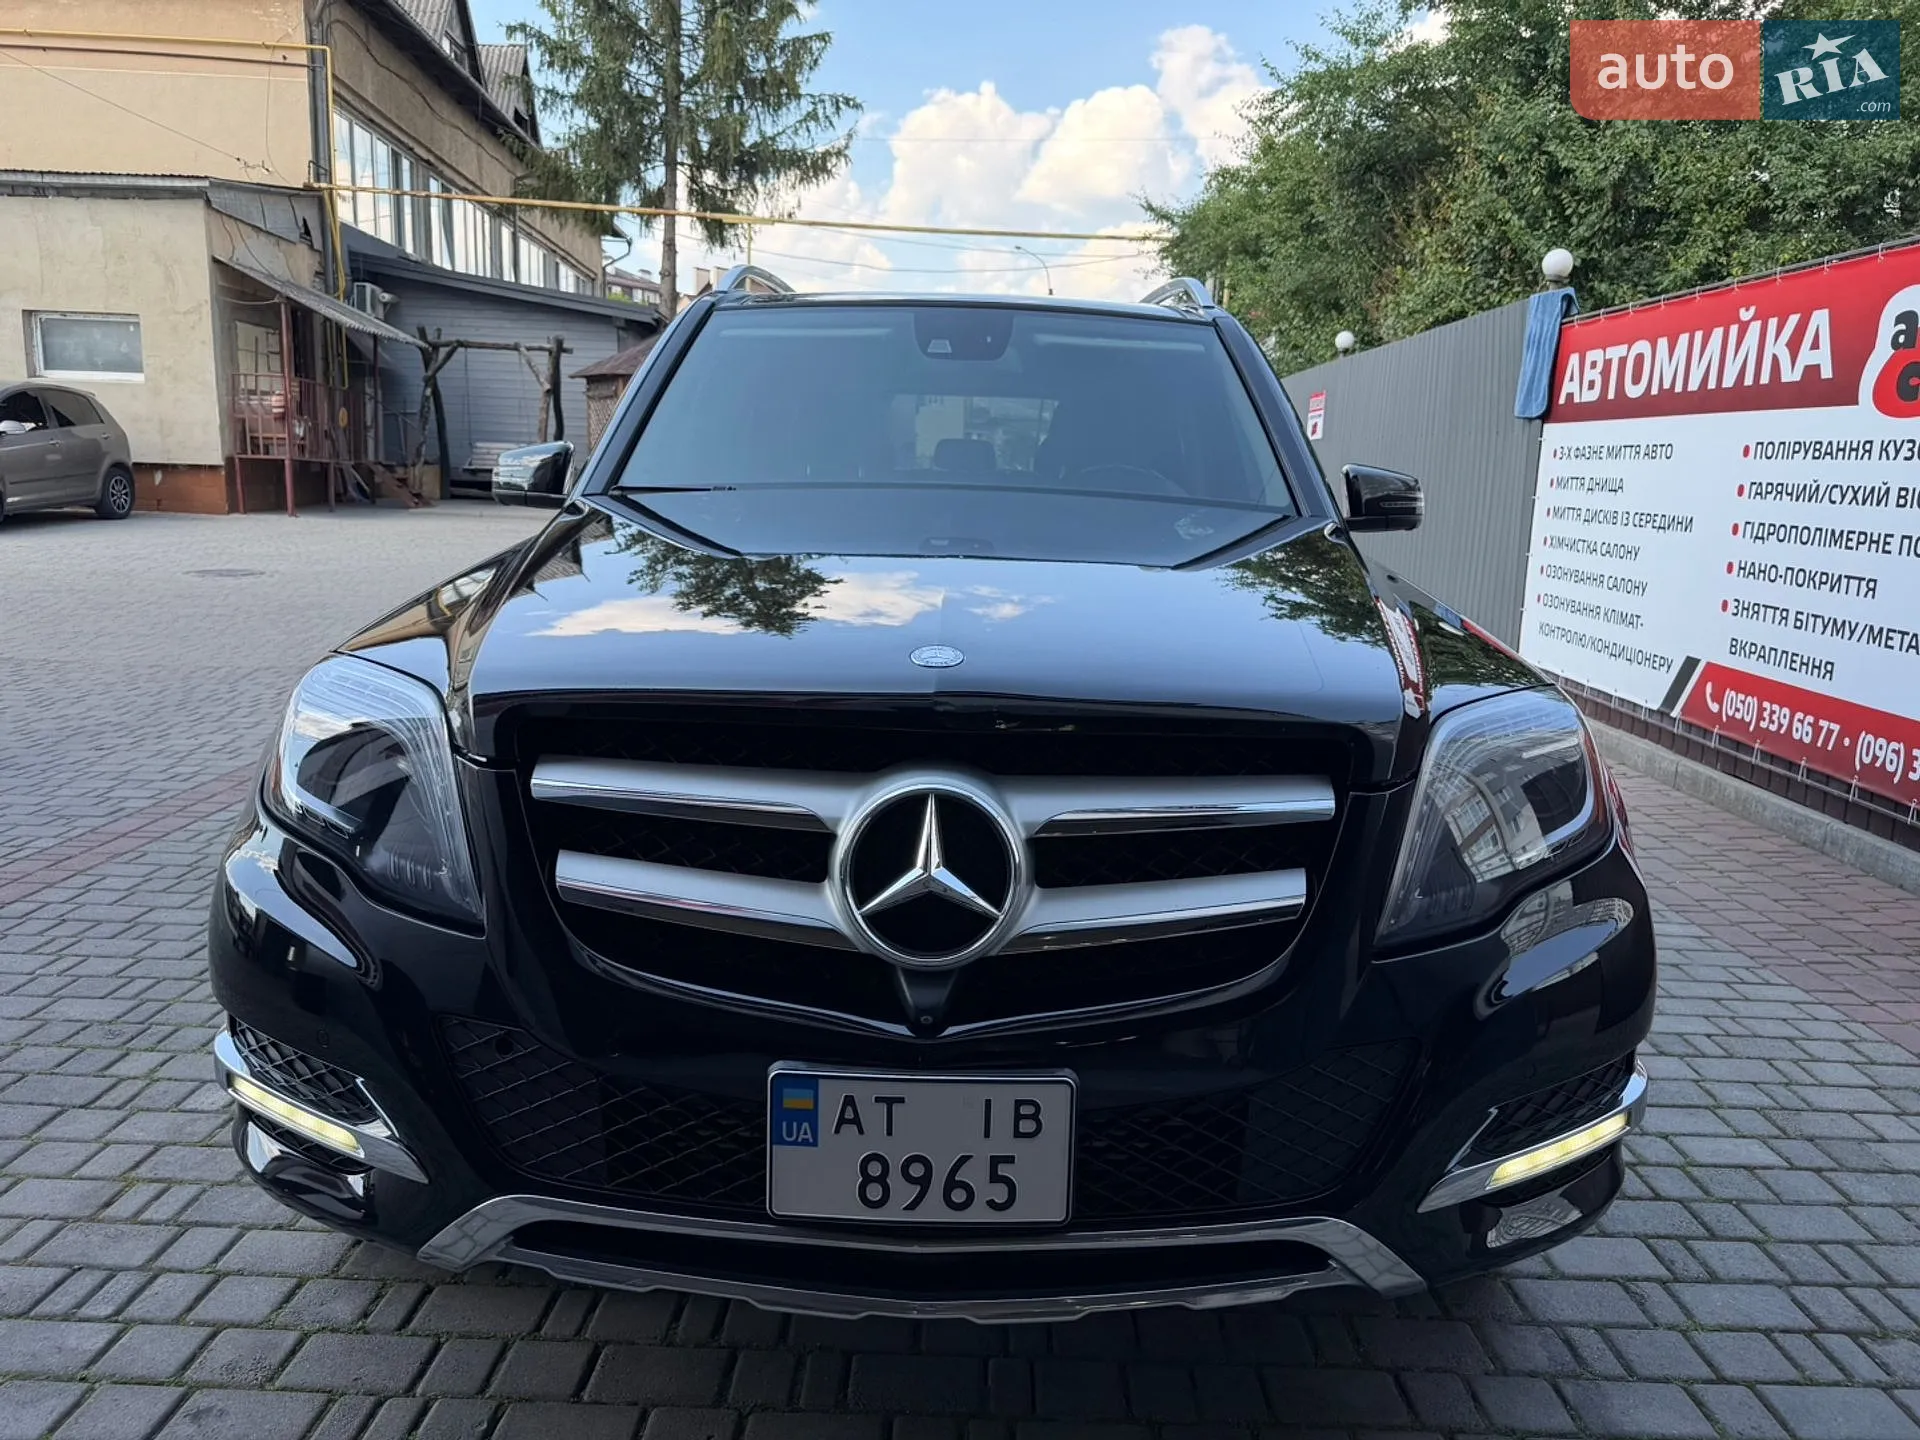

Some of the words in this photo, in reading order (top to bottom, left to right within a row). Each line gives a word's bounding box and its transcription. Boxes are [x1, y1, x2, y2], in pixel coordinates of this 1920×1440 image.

[1558, 306, 1833, 404] АВТОМИЙКА
[1573, 445, 1605, 460] ФАЗНЕ
[1606, 444, 1641, 460] МИТТЯ
[1642, 443, 1674, 460] АВТО
[1753, 440, 1874, 461] ПОЛІРУВАННЯ
[1878, 438, 1920, 461] КУЗ
[1555, 476, 1585, 491] МИТТЯ
[1586, 477, 1624, 495] ДНИЩА
[1748, 479, 1891, 508] ГАРЯЧИЙ/СУХИЙ
[1895, 486, 1920, 510] ВІ
[1552, 505, 1582, 522] МИТТЯ
[1583, 508, 1619, 526] ДИСКІВ
[1620, 511, 1631, 527] ІЗ
[1632, 511, 1694, 533] СЕРЕДИНИ
[1548, 535, 1598, 556] ХІМЧИСТКА
[1600, 541, 1641, 561] САЛОНУ
[1742, 521, 1895, 555] ГІДРОПОЛІМЕРНЕ
[1545, 564, 1605, 589] ОЗОНУВАННЯ
[1606, 575, 1648, 597] САЛОНУ
[1736, 559, 1878, 600] НАНО-ПОКРИТТЯ
[1542, 593, 1601, 621] ОЗОНУВАННЯ
[1602, 607, 1644, 631] КЛІМАТ-
[1731, 598, 1790, 628] ЗНЯТТЯ
[1793, 610, 1920, 656] БІТУМУ/МЕТА
[1538, 621, 1674, 673] КОНТРОЛЮ/КОНДИЦІОНЕРУ
[1729, 637, 1835, 681] ВКРАПЛЕННЯ
[1722, 688, 1758, 732] (050)
[1759, 701, 1790, 734] 339
[1792, 711, 1814, 744] 66
[1816, 719, 1840, 751] 77
[1855, 730, 1905, 784] (096)
[782, 1121, 814, 1143] UA
[832, 1093, 906, 1137] AT
[983, 1098, 1044, 1139] IB
[856, 1151, 1019, 1211] 8965
